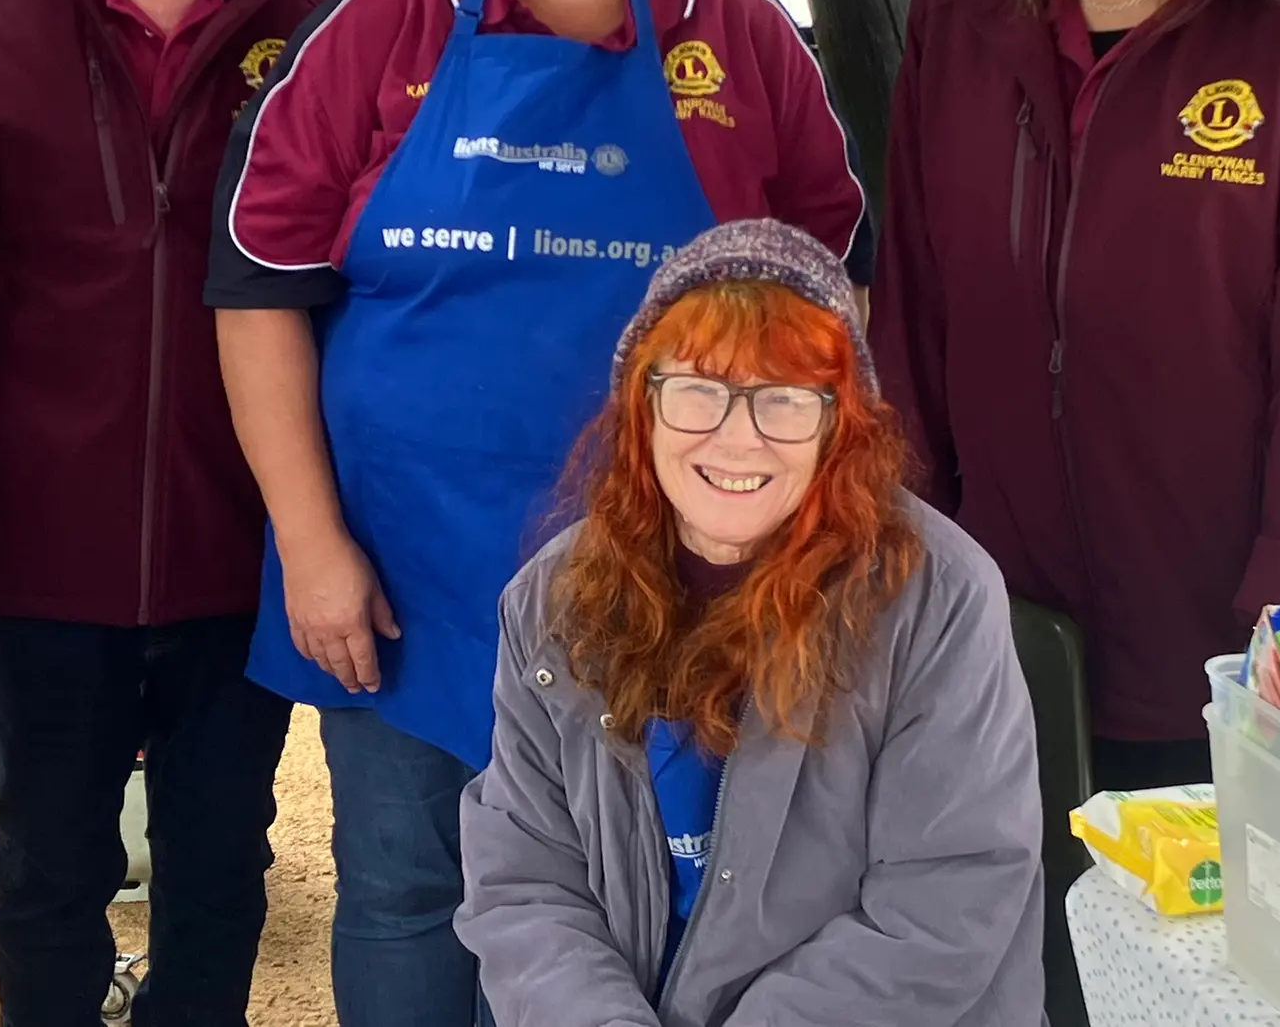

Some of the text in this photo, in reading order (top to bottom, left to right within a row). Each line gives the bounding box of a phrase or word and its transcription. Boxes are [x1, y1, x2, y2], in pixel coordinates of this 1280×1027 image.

[1207, 100, 1235, 127] L
[1160, 162, 1266, 186] WARBY RANGES
[1172, 152, 1256, 172] GLENROWAN
[382, 226, 415, 249] we
[421, 227, 494, 252] serve
[1189, 876, 1223, 892] Detto
